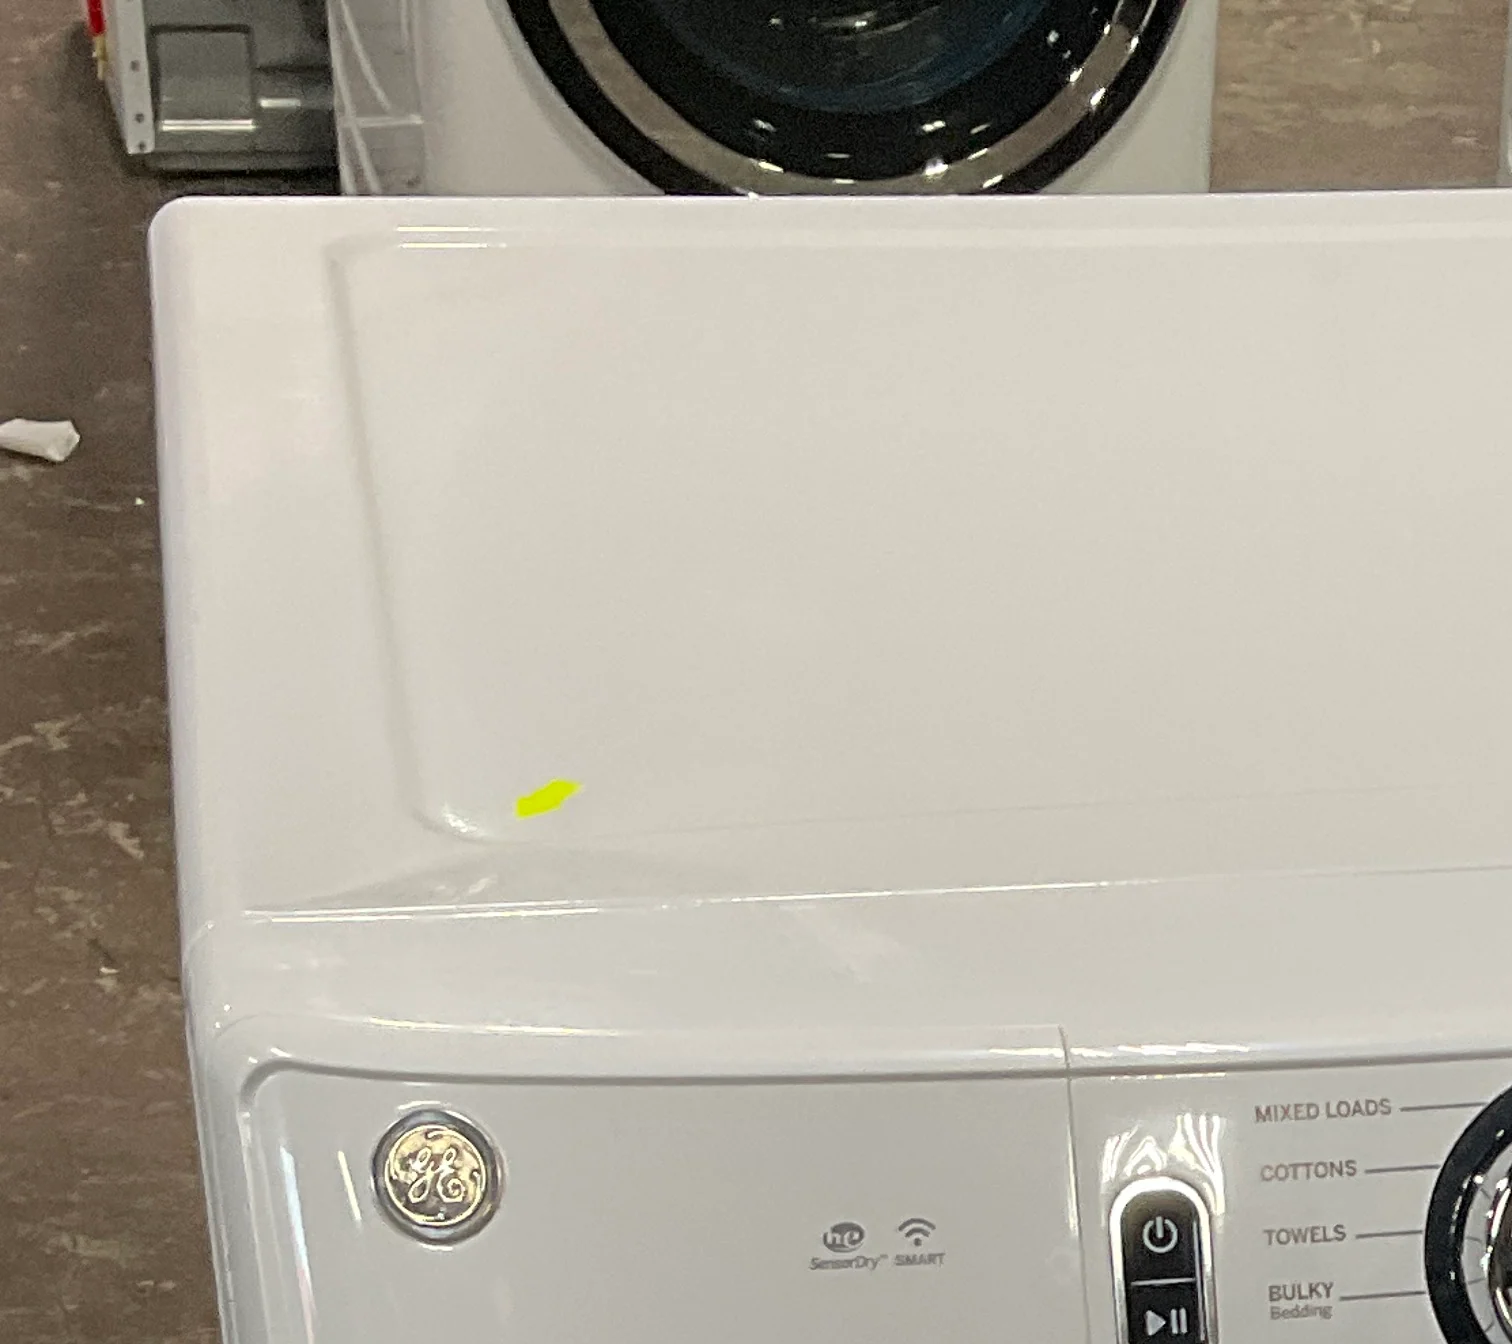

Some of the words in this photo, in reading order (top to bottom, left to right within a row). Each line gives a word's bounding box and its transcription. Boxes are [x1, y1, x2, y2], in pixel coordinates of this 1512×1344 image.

[1255, 1103, 1319, 1122] MIXED
[1326, 1098, 1391, 1118] LOADS
[1261, 1160, 1357, 1181] COTTONS
[1264, 1224, 1346, 1245] TOWELS
[895, 1253, 945, 1266] SMART
[1269, 1282, 1333, 1302] BULKY
[1270, 1304, 1332, 1320] Bedding
